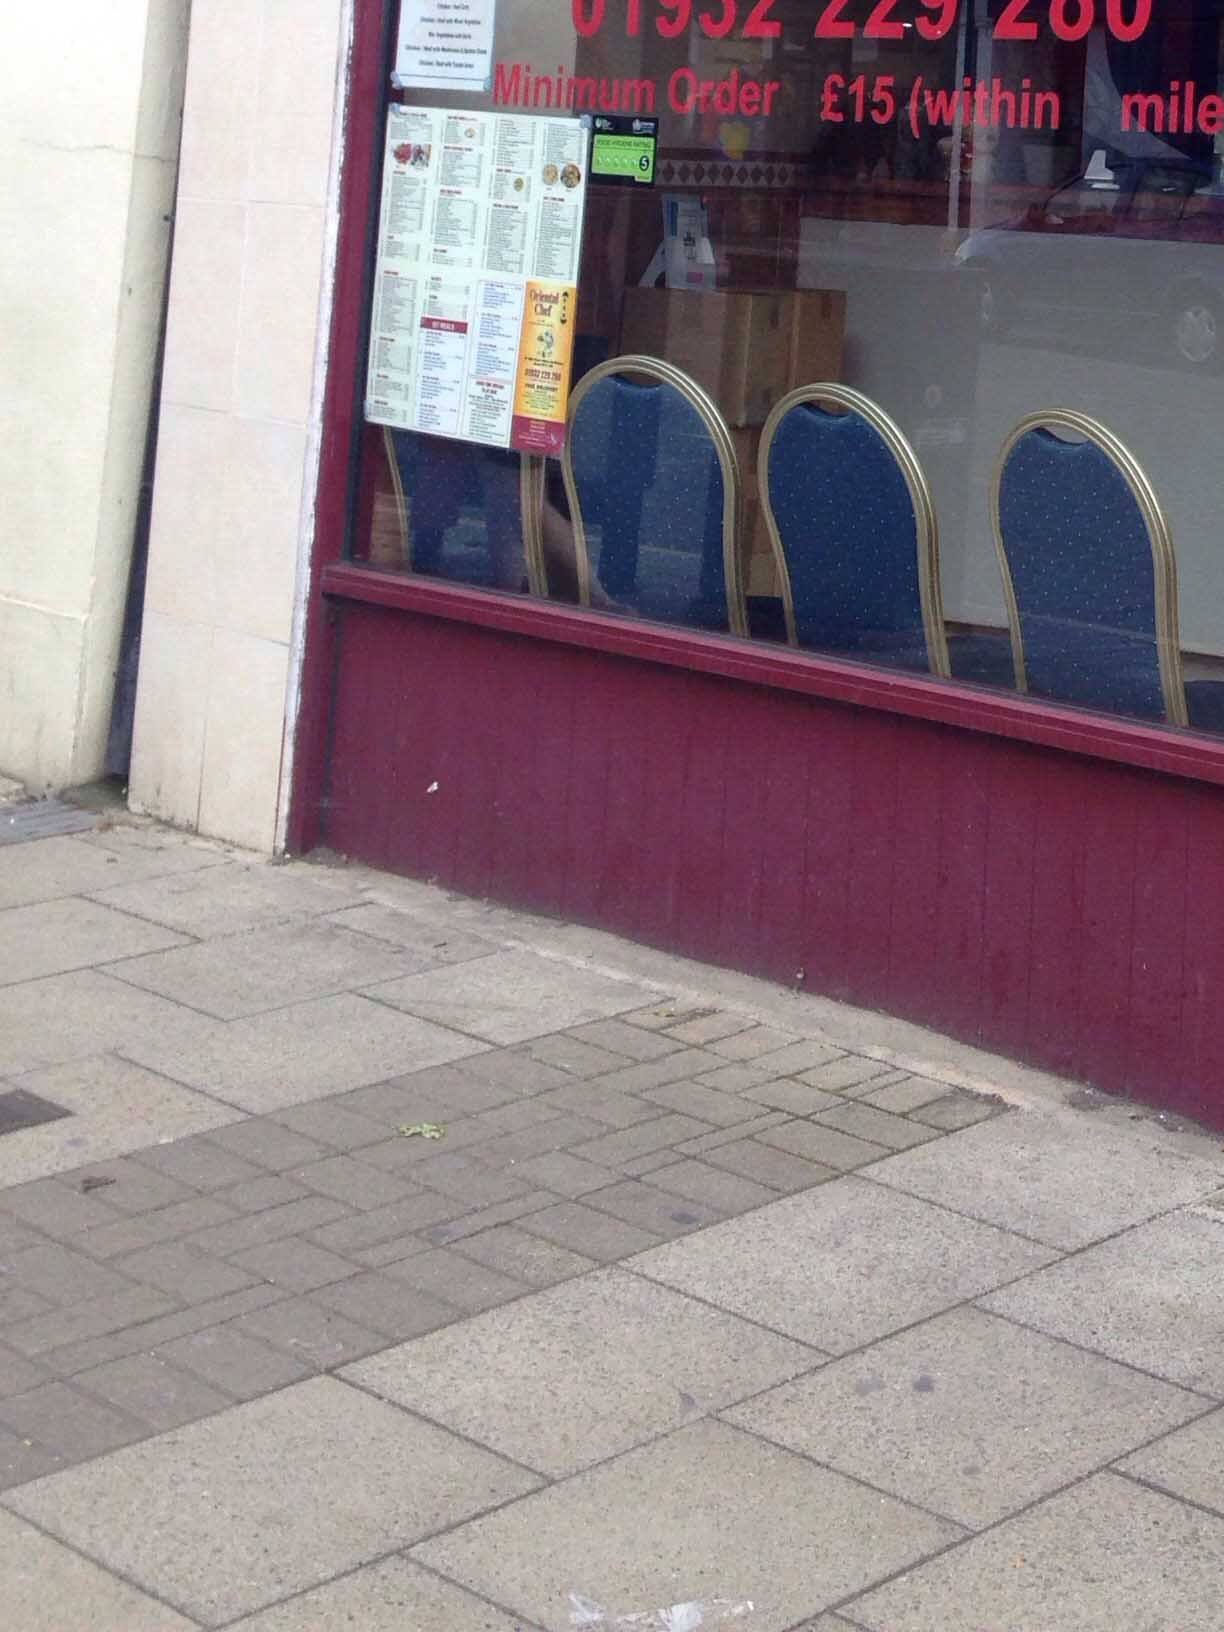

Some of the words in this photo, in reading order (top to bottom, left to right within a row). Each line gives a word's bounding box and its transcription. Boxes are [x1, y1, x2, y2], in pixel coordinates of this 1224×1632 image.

[492, 63, 656, 112] Minimum
[667, 67, 781, 116] Order
[819, 74, 897, 125] £15
[908, 75, 1061, 139] (within
